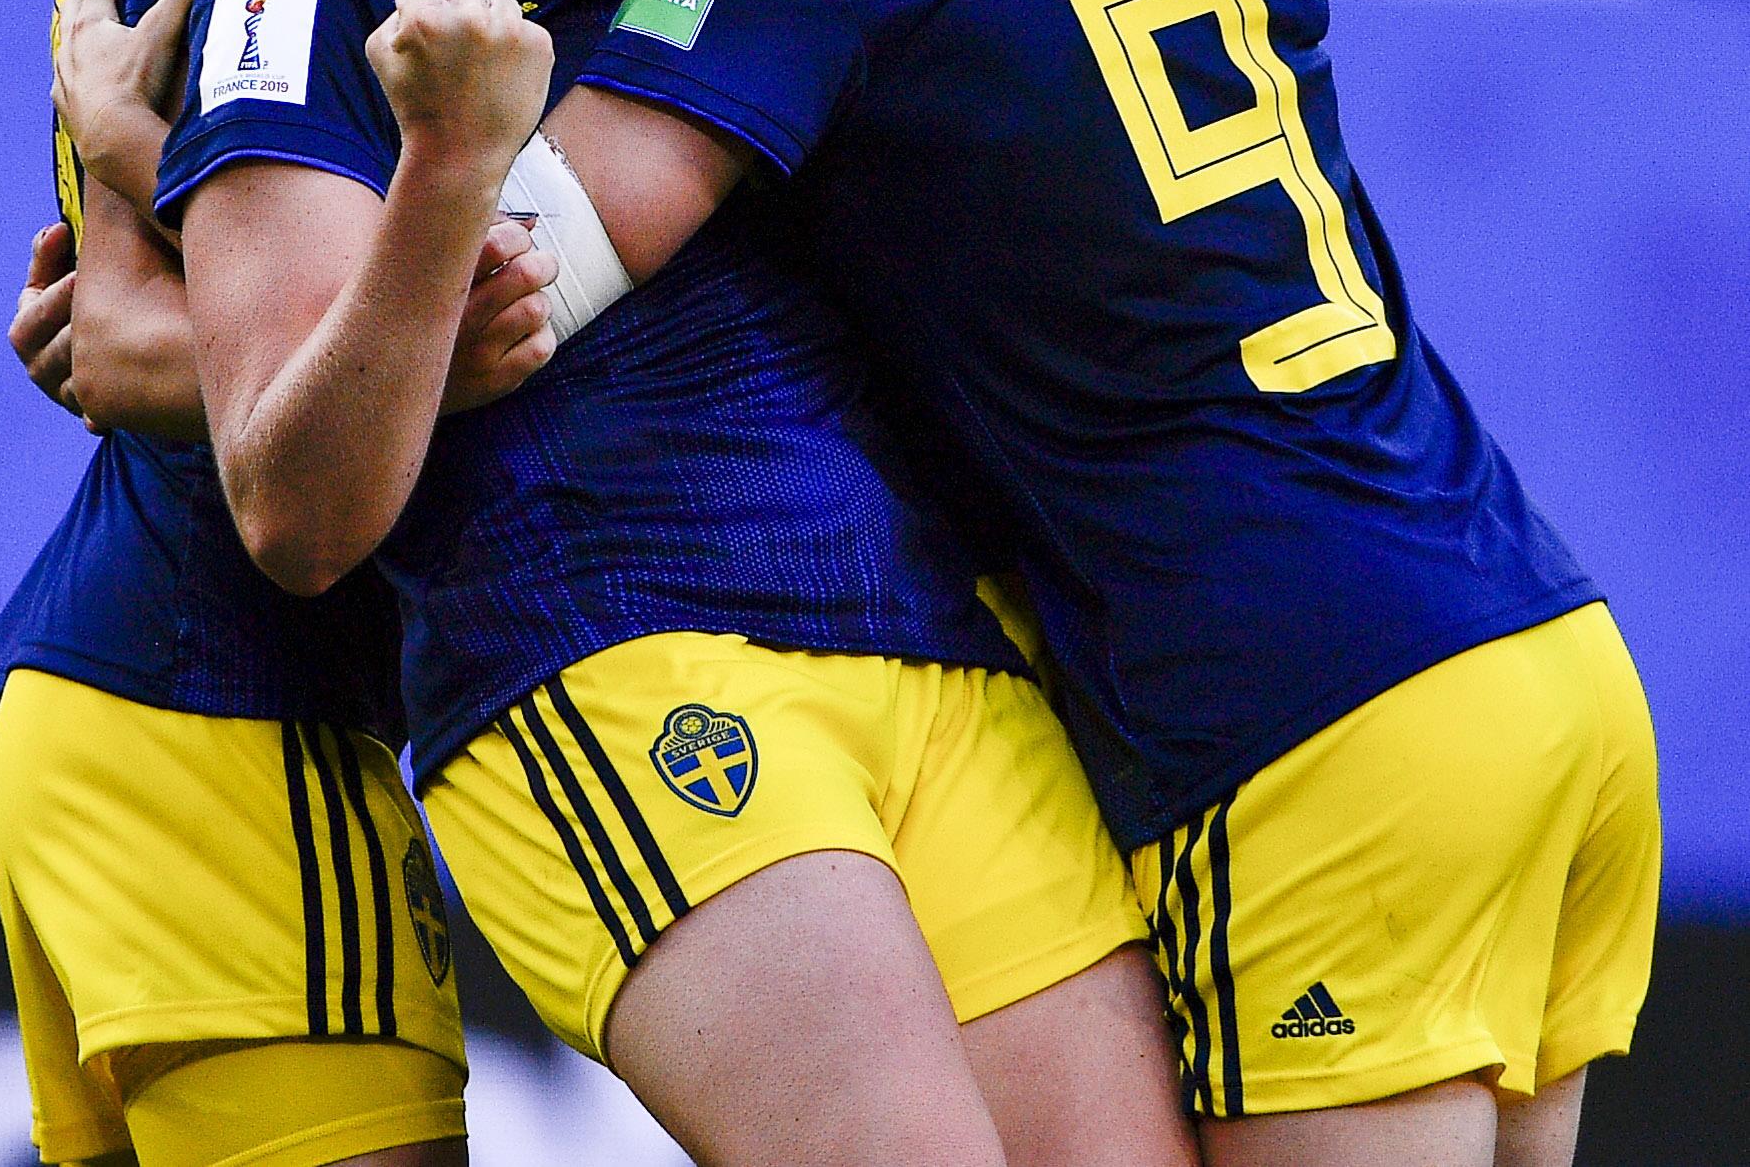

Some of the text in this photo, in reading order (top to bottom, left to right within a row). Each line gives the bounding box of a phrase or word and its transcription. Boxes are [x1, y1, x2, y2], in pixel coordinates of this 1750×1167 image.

[213, 79, 289, 98] FRANCE 2019
[671, 730, 730, 758] SVERIGE
[1271, 1017, 1355, 1038] adidas
